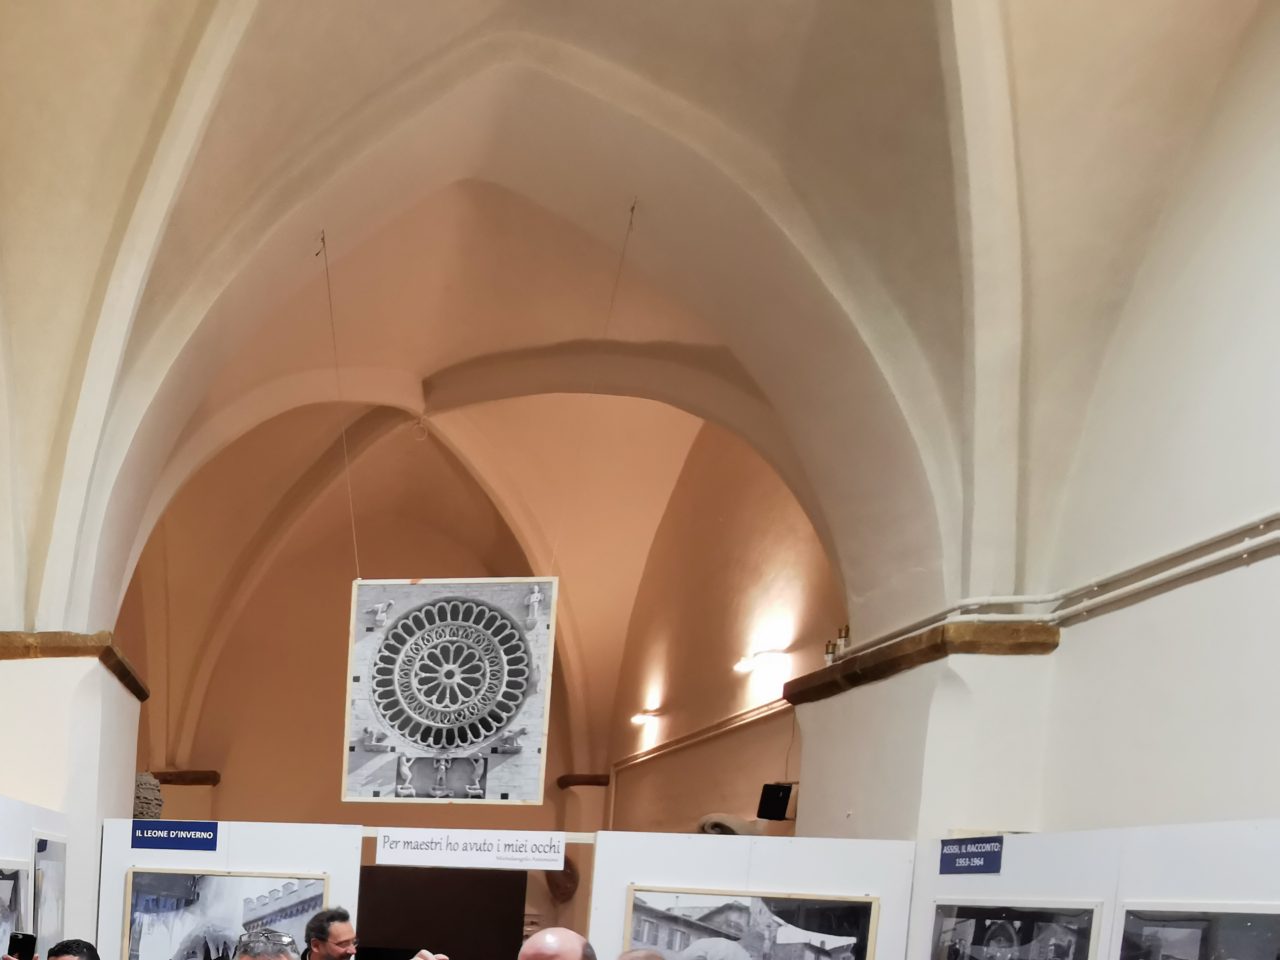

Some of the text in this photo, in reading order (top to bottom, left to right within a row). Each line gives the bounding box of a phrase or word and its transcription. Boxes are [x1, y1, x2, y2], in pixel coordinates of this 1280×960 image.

[135, 829, 214, 839] IL LEONE D'INVERNO
[382, 835, 401, 850] Per
[403, 837, 443, 851] maestri
[446, 835, 459, 852] ho
[462, 839, 494, 852] avuto
[504, 839, 528, 854] miei
[531, 837, 561, 854] occhi
[967, 843, 1001, 852] RACCONTO:
